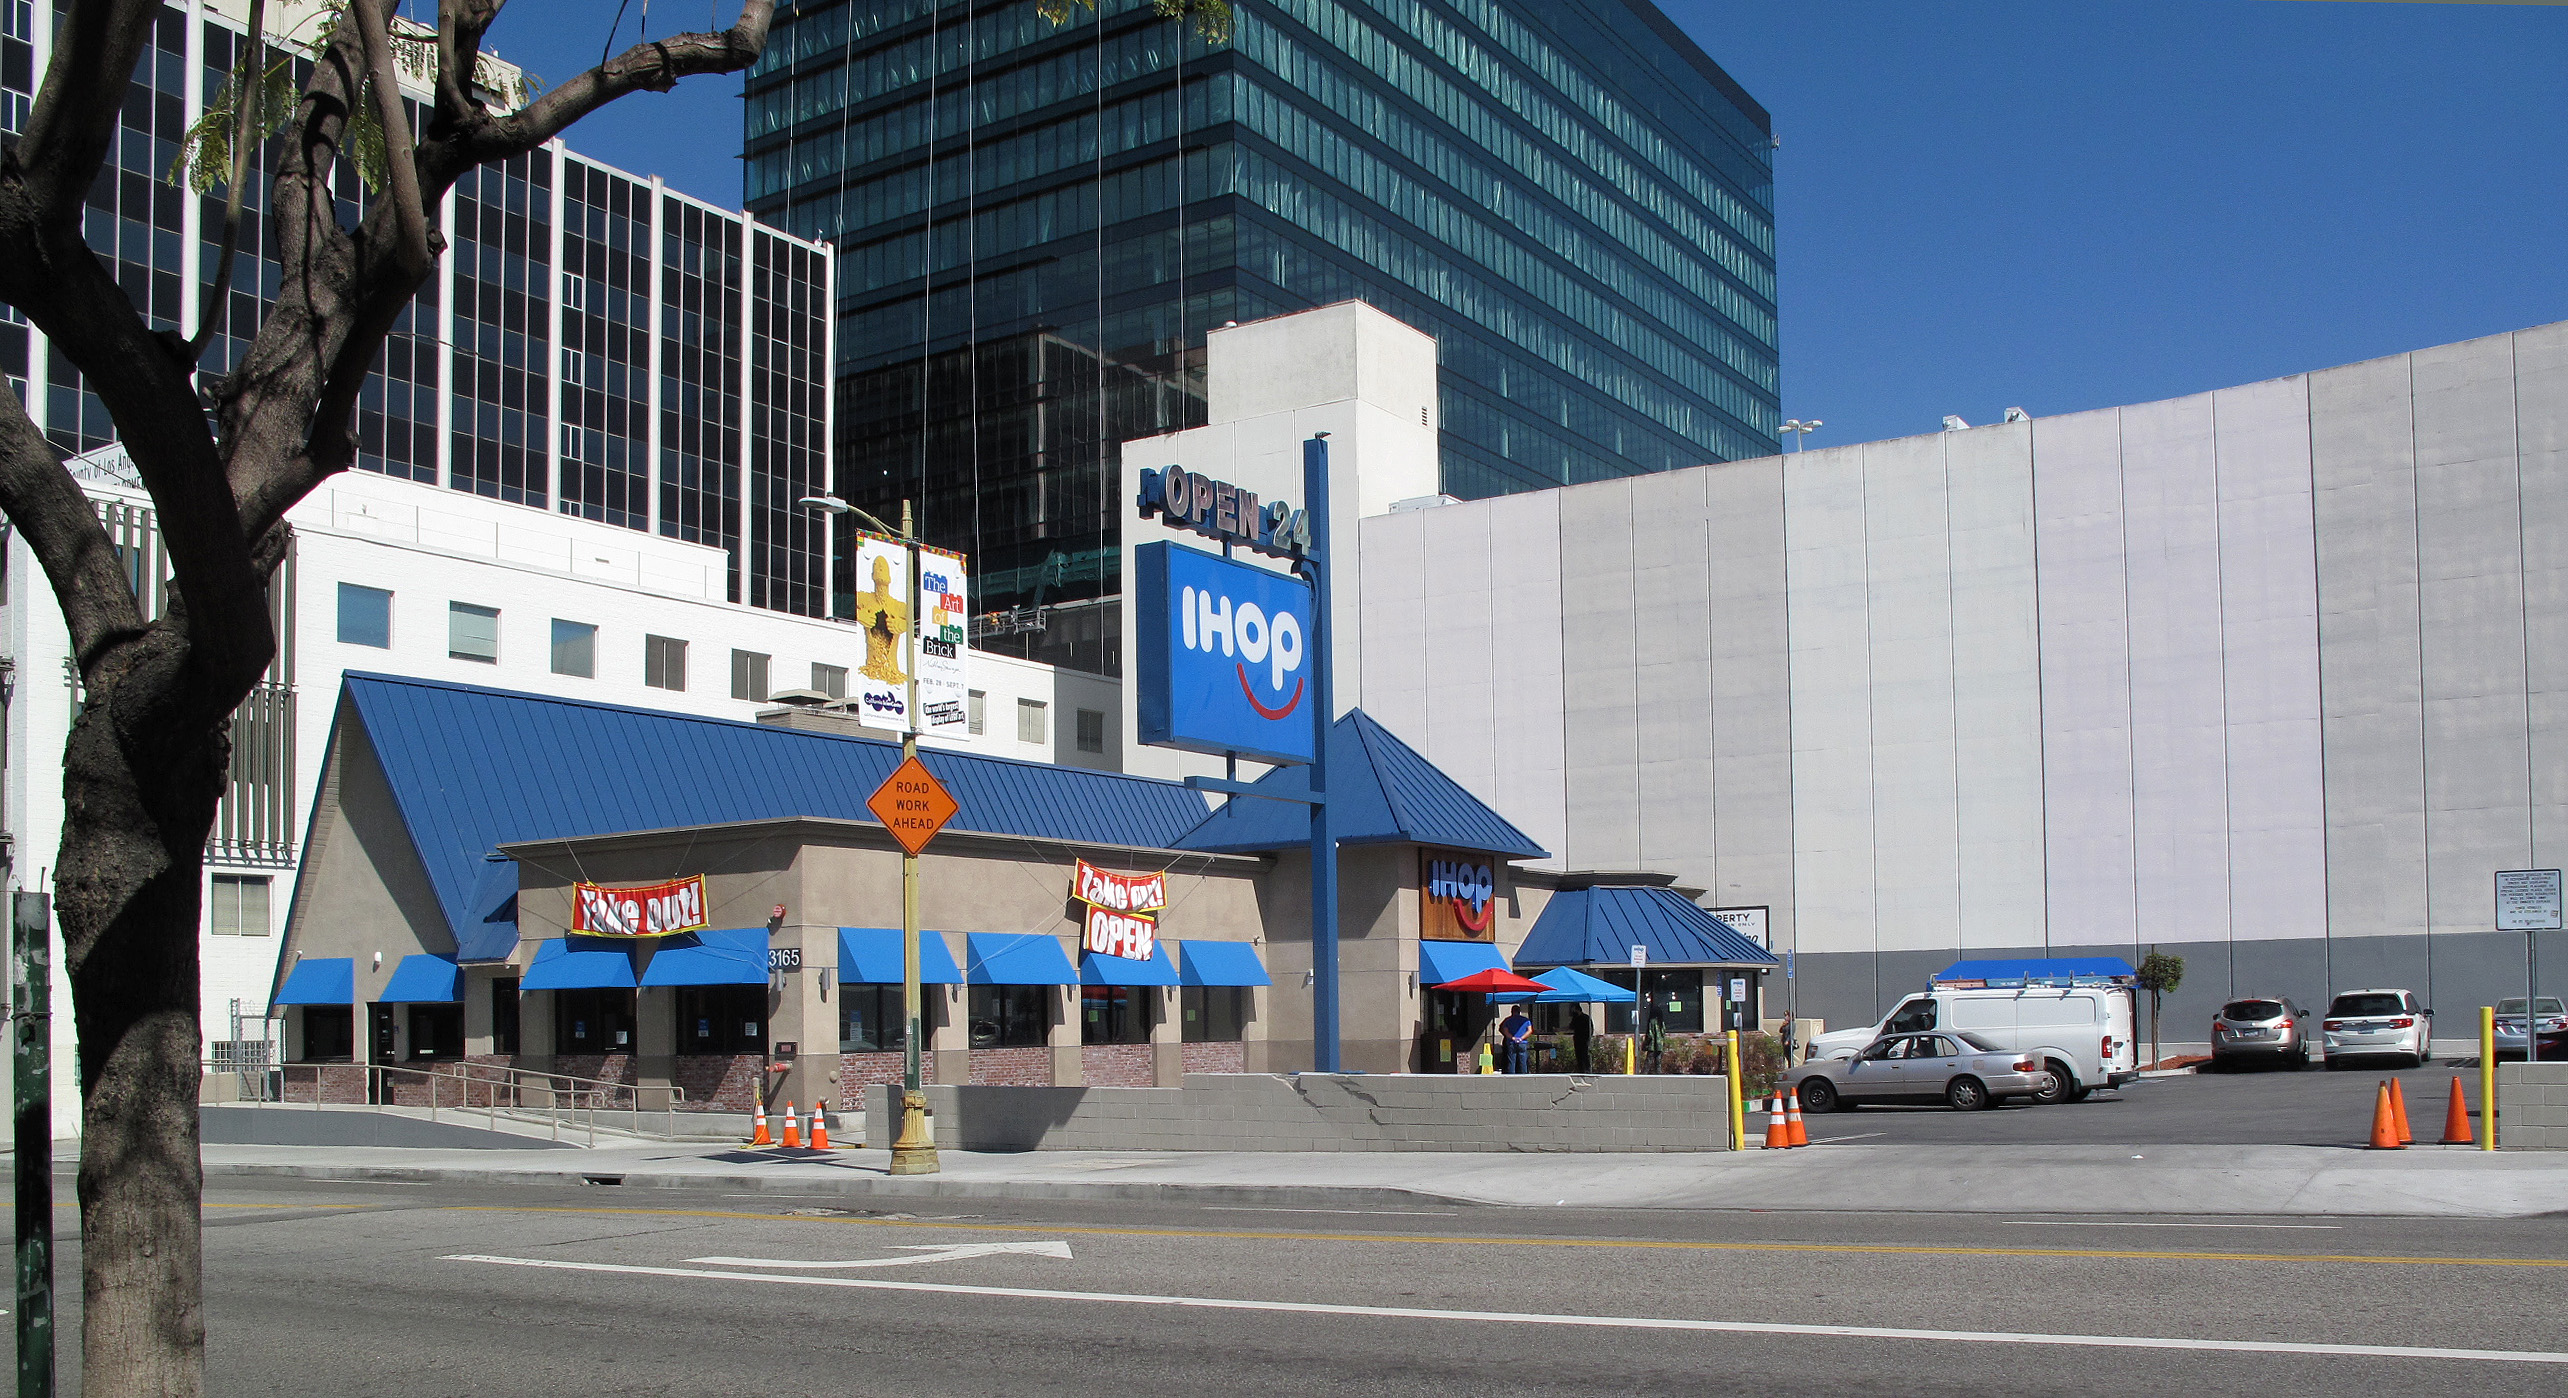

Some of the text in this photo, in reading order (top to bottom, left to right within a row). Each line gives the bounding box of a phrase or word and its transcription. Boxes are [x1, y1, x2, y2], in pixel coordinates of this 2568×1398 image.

[94, 460, 101, 479] of
[103, 458, 115, 476] Los
[1160, 464, 1312, 556] OPEN 24
[924, 576, 946, 593] The
[944, 596, 960, 612] Art
[934, 611, 945, 624] of
[943, 627, 960, 644] the
[1182, 585, 1303, 691] IHOP
[926, 639, 954, 658] Brick
[923, 677, 934, 685] FEB.
[946, 681, 960, 690] SEPT.
[896, 781, 929, 793] ROAD
[896, 800, 929, 811] WORK
[893, 817, 934, 829] AHEAD
[1081, 865, 1128, 910] Take
[1430, 860, 1493, 914] IHOP
[646, 881, 701, 934] out!
[1090, 911, 1152, 961] OPEN
[768, 949, 800, 966] 3165
